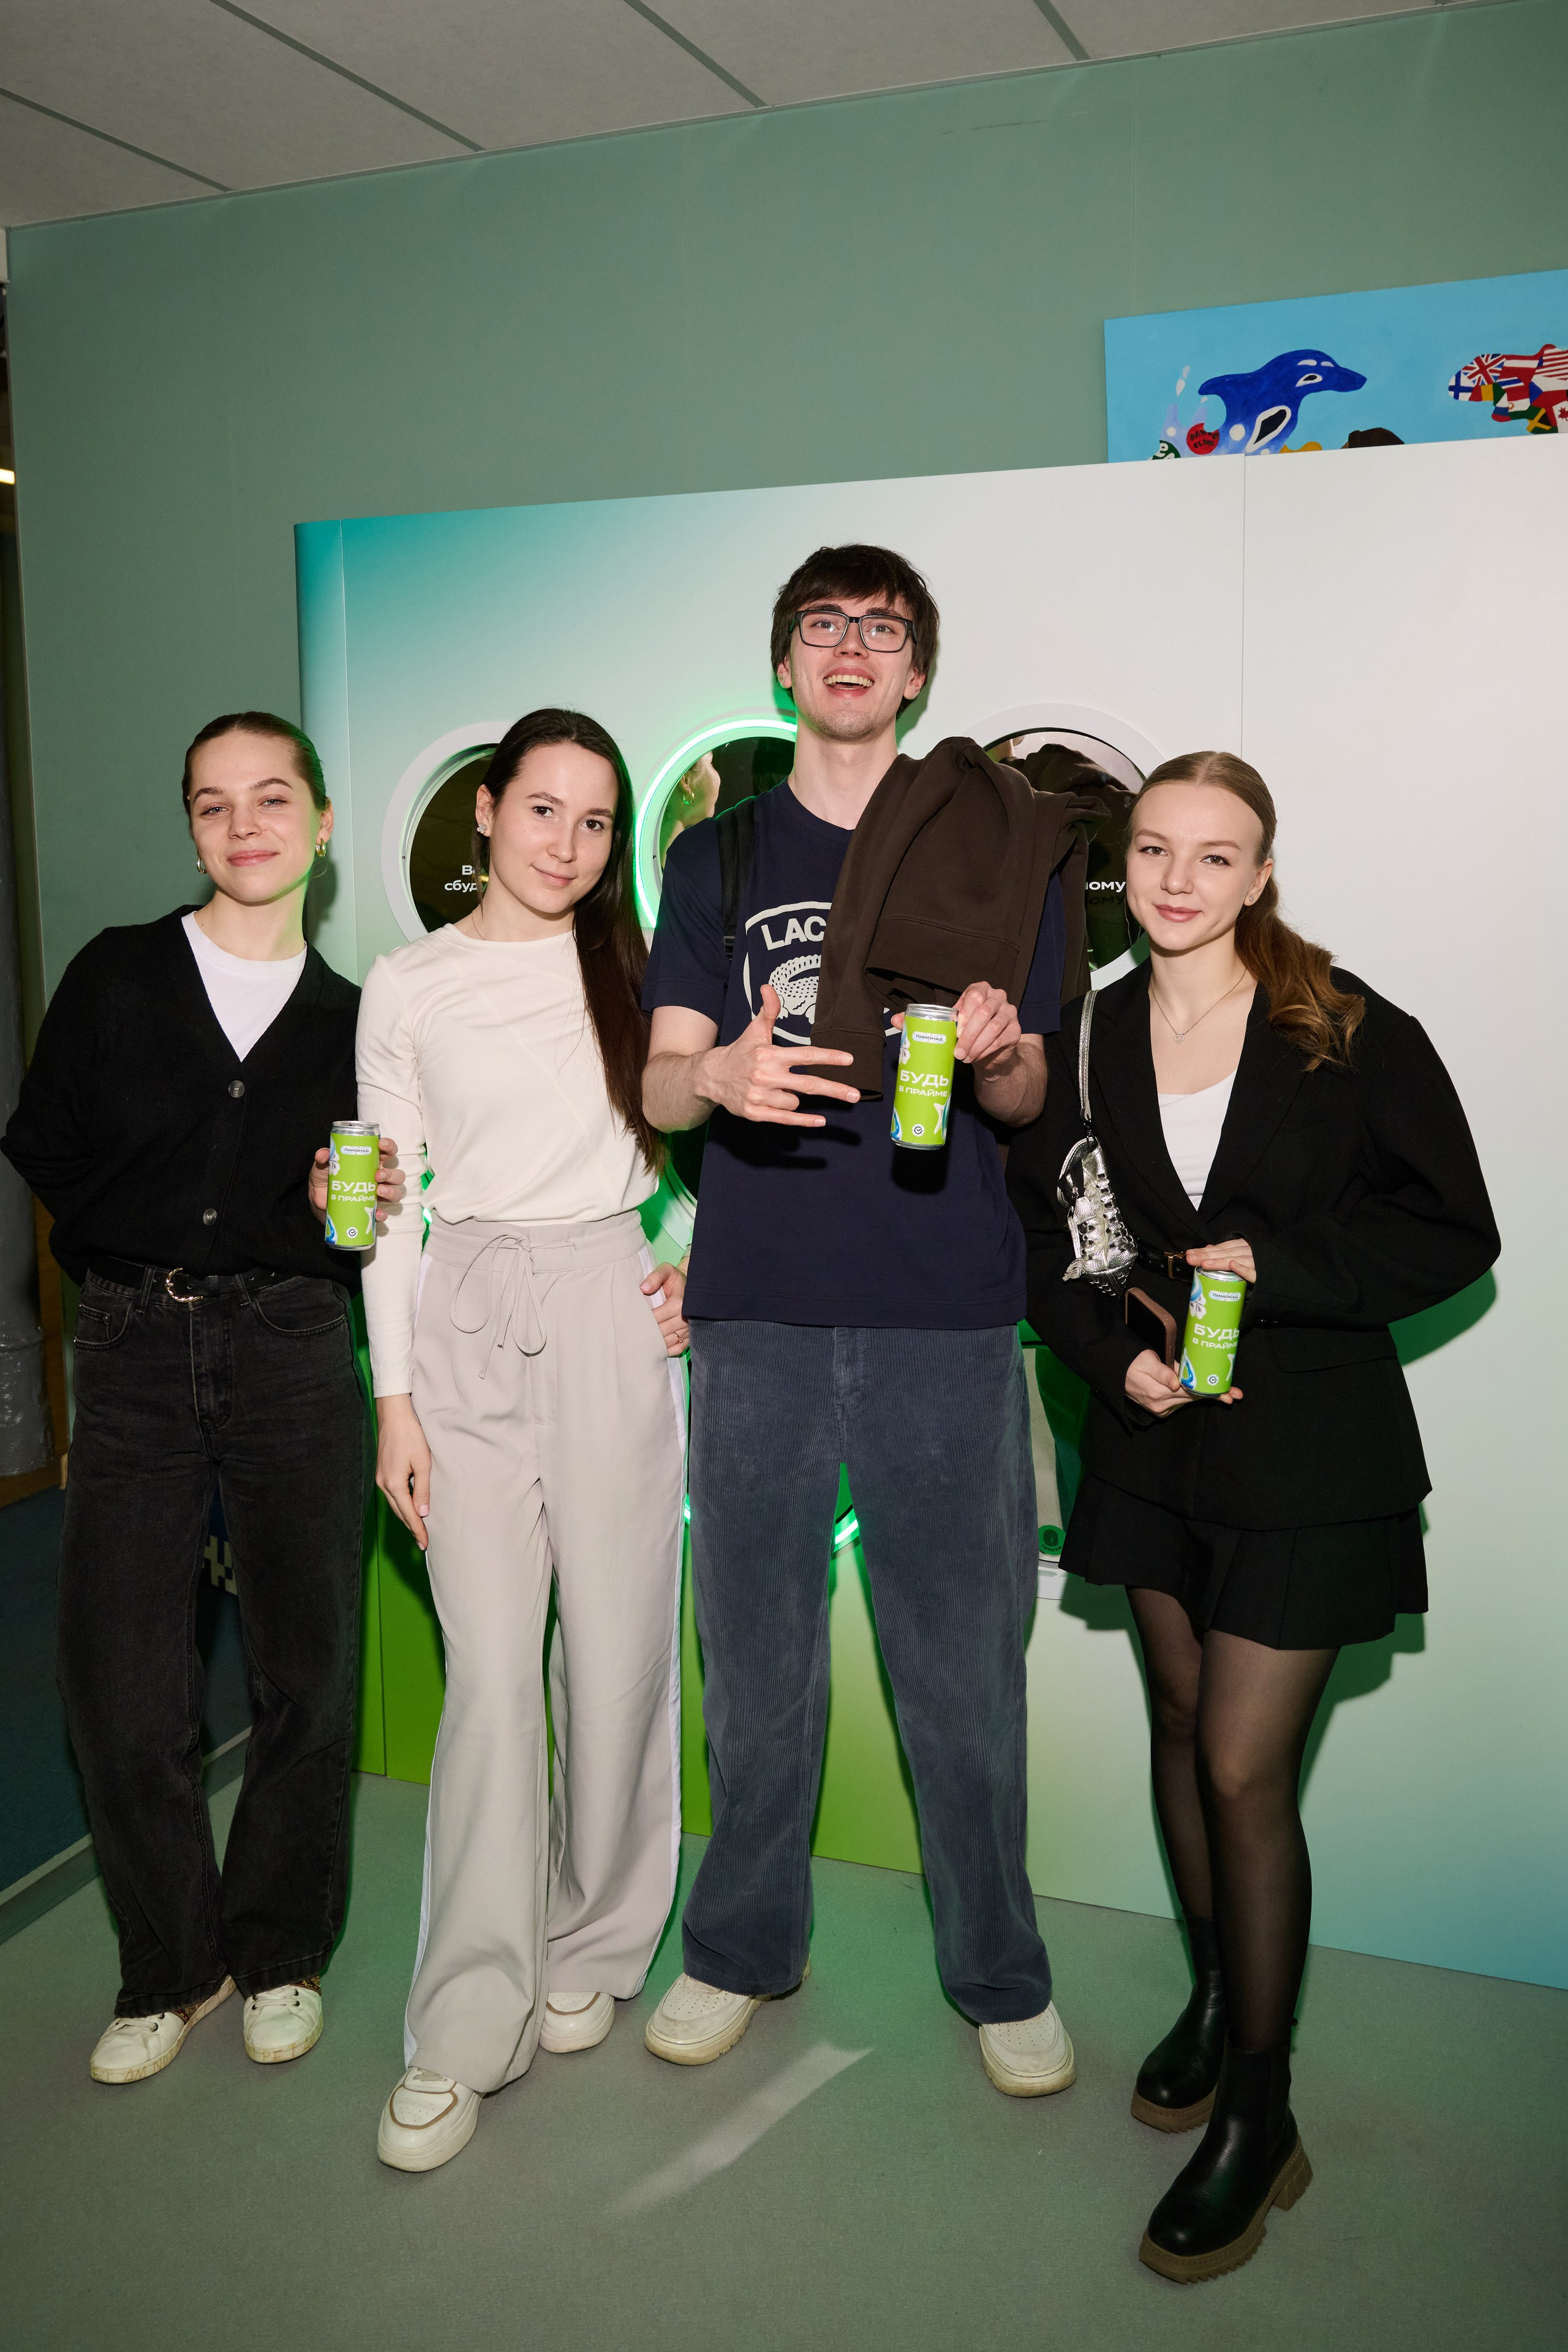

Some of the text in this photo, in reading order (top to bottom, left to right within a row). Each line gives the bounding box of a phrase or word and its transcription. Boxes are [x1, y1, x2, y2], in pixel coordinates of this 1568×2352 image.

[761, 916, 827, 951] LAC
[900, 1069, 949, 1087] БУДЬ
[905, 1087, 948, 1097] ПРАЙМЕ
[331, 1180, 376, 1194] БУДЬ
[1194, 1323, 1240, 1341] БУДЬ
[1200, 1340, 1238, 1350] ПРАЙМЕ
